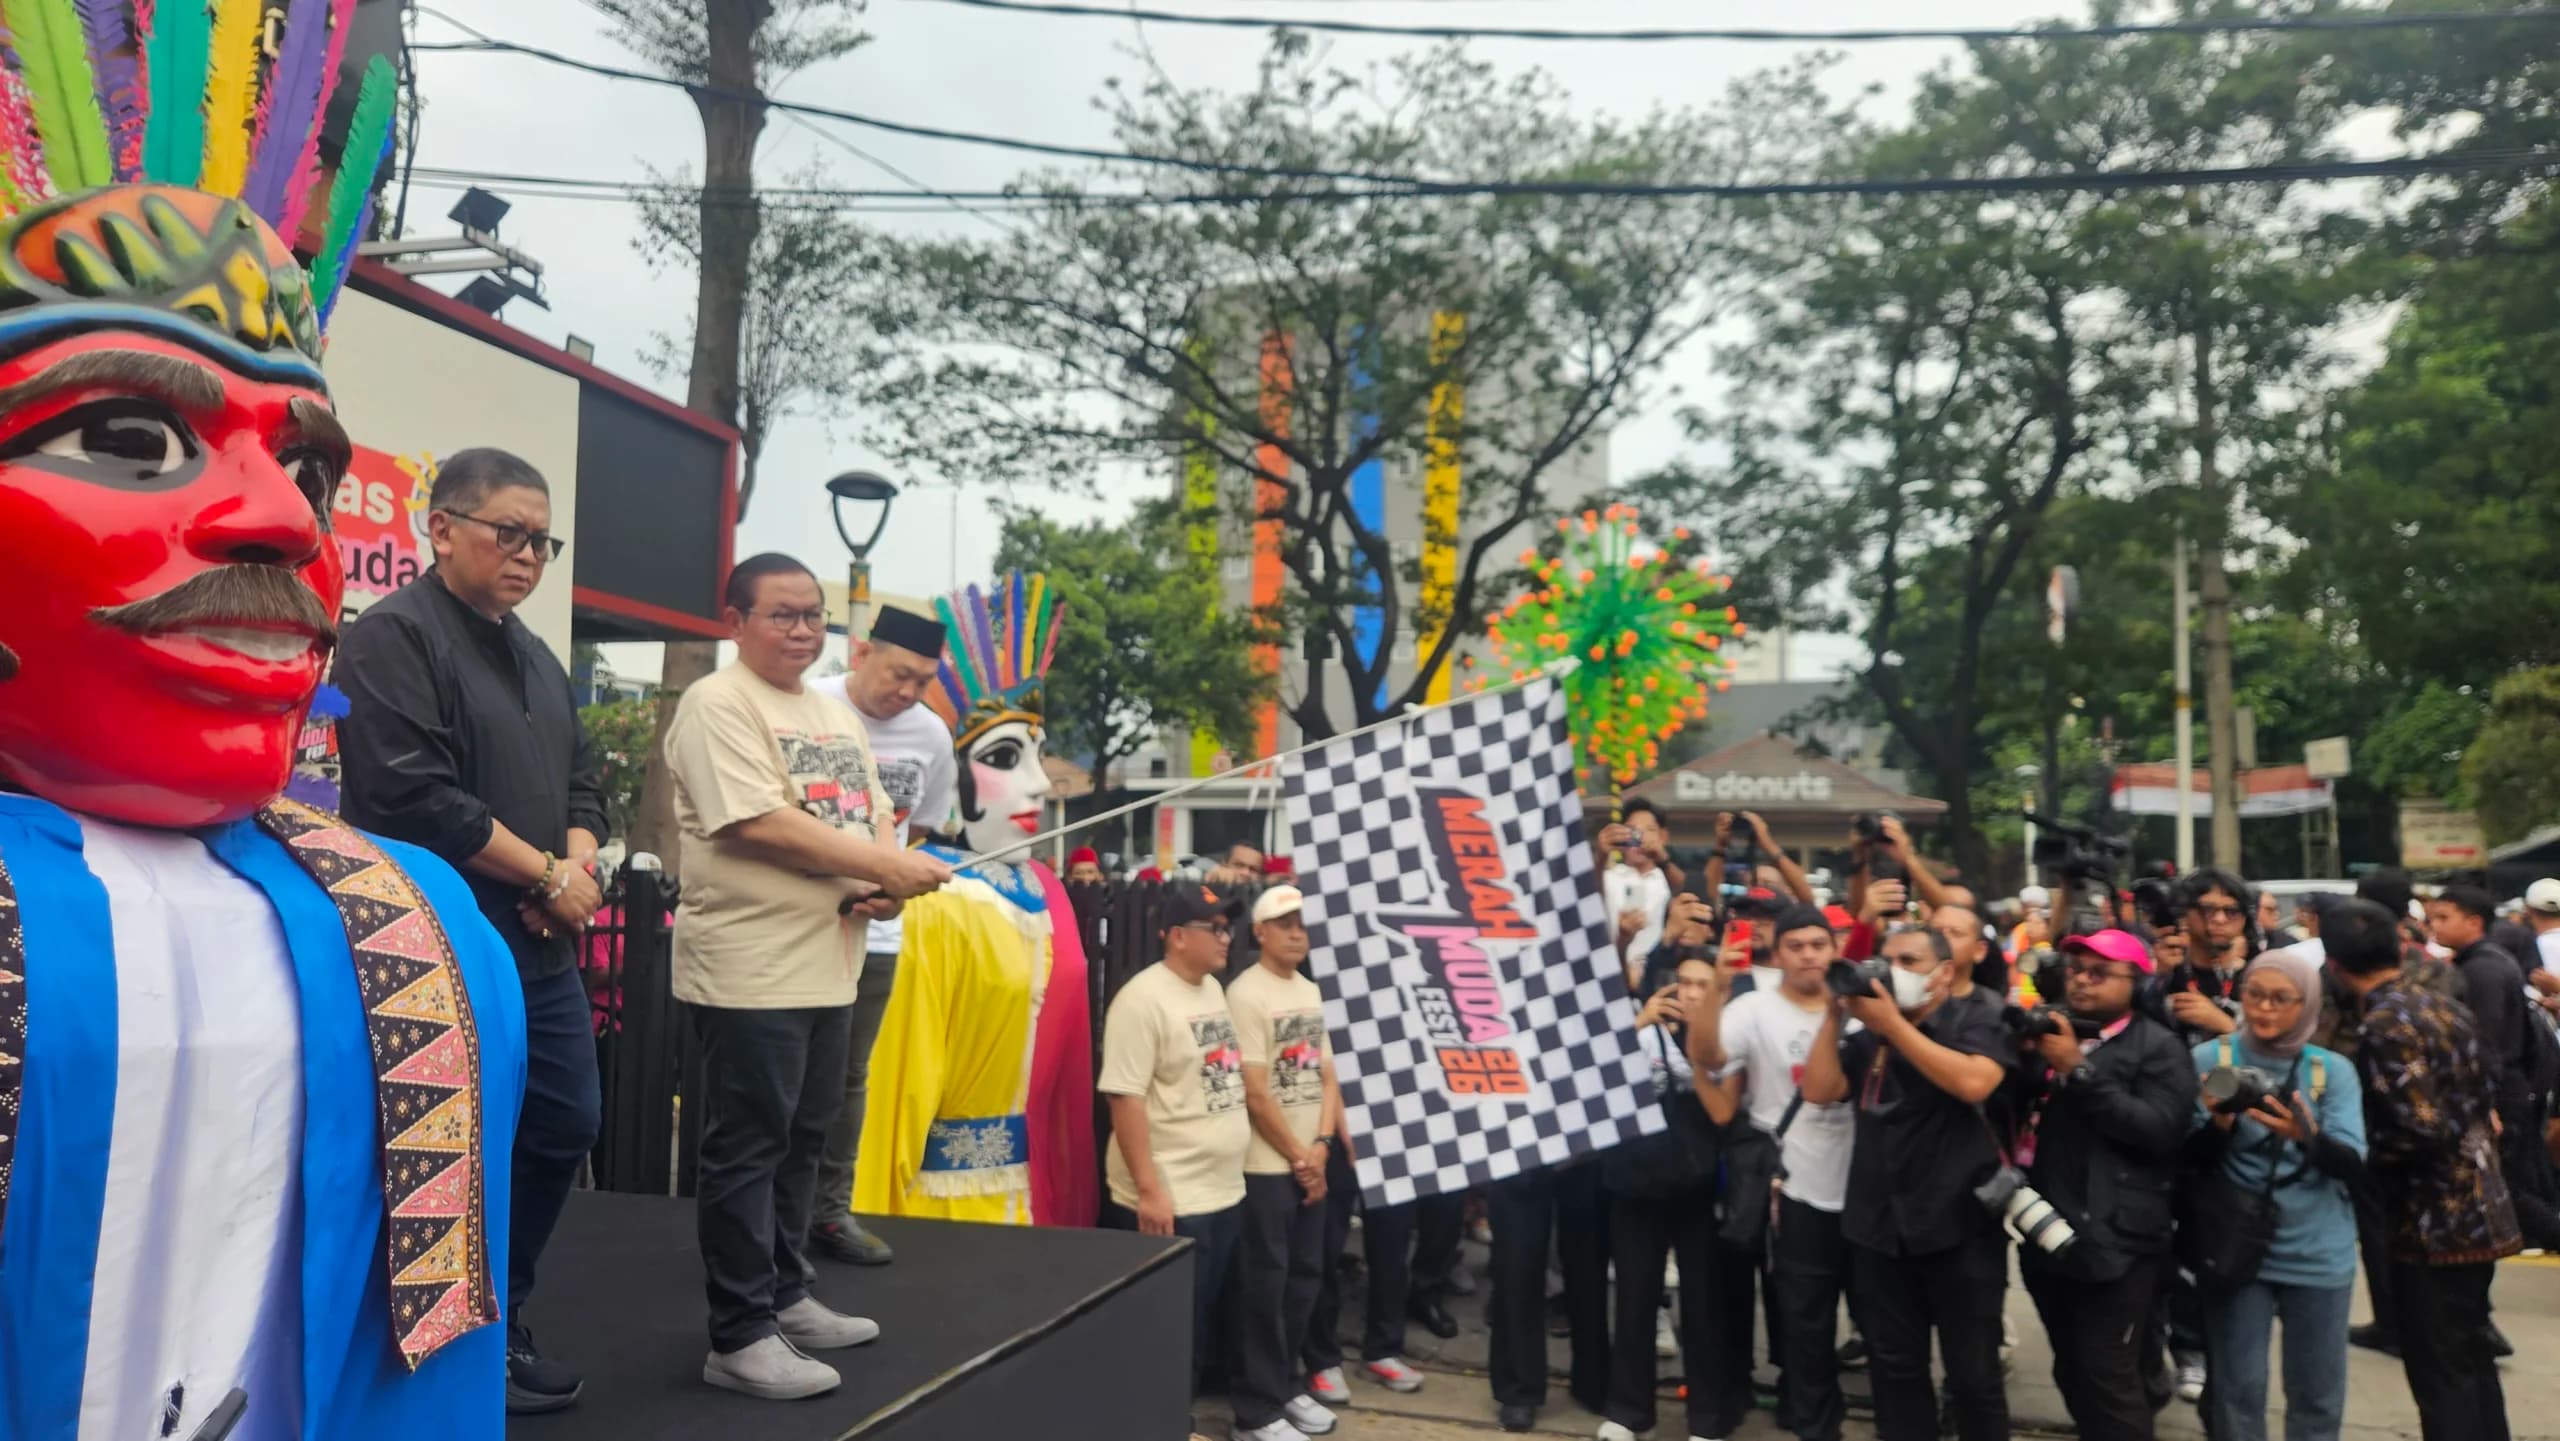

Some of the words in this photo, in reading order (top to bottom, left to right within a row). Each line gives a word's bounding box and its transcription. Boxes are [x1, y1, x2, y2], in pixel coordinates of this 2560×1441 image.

[334, 472, 394, 525] as
[341, 542, 419, 588] uda
[1715, 770, 1832, 800] donuts
[1437, 797, 1539, 938] MERAH
[1402, 925, 1511, 1043] MUDA
[1415, 986, 1467, 1047] FEST
